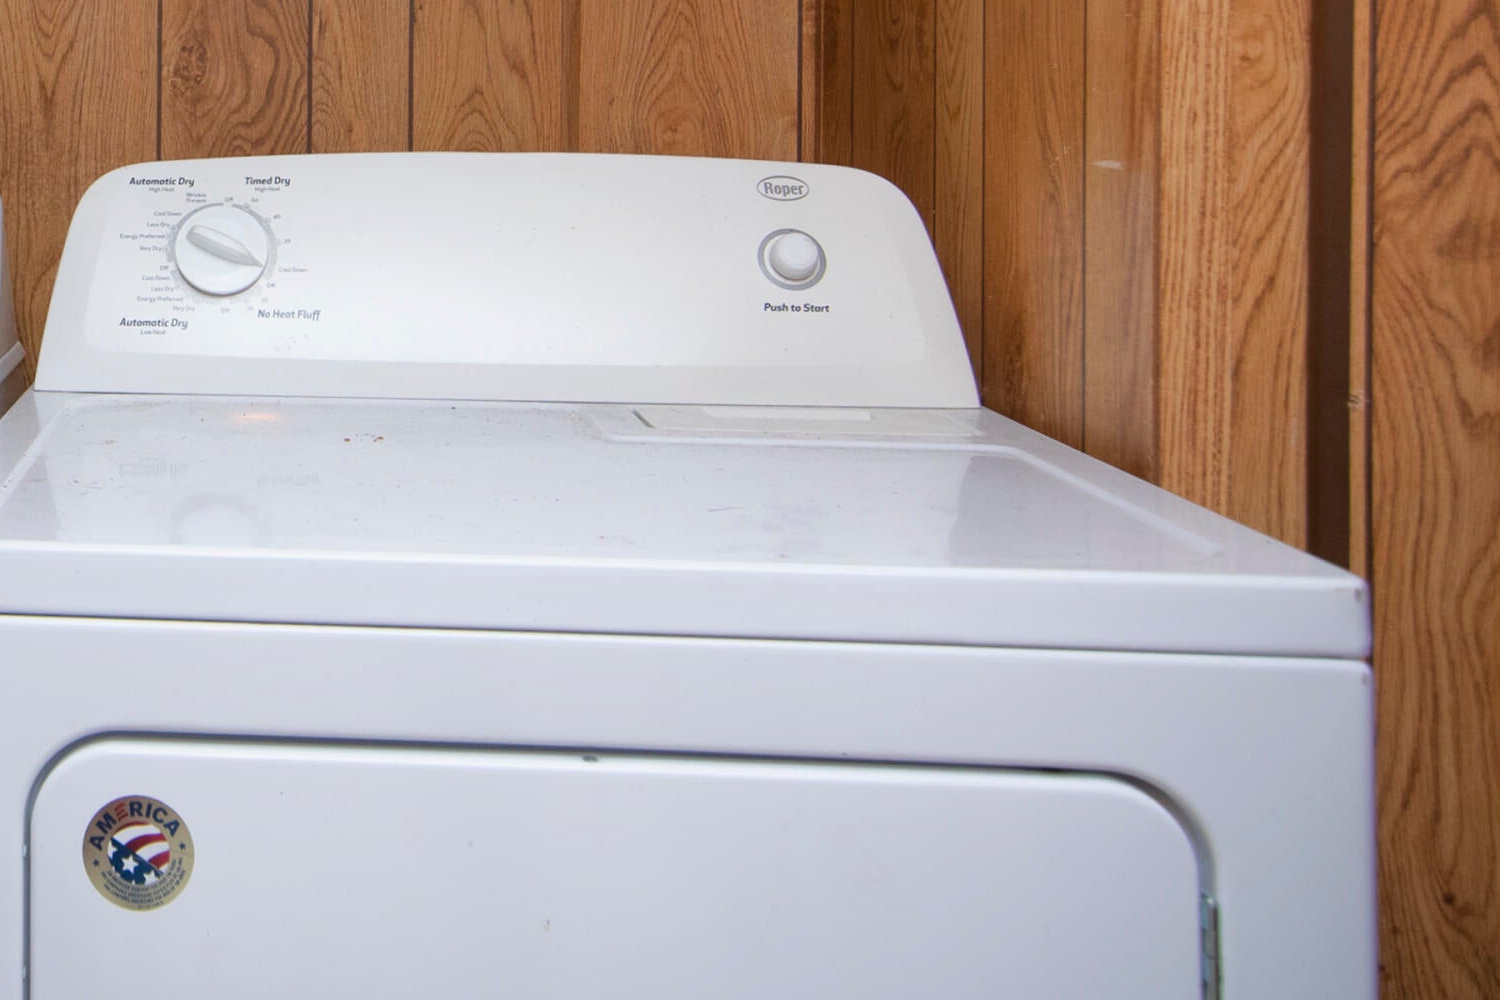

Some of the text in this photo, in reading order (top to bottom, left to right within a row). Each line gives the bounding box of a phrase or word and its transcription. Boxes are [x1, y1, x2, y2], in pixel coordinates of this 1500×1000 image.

[129, 177, 195, 188] Automatic Dry
[245, 176, 291, 187] Timed Dry
[763, 182, 804, 197] Roper
[764, 303, 830, 312] Push to Start
[257, 310, 321, 321] No Heat Fluff
[119, 317, 189, 330] Automatic Dry
[89, 801, 180, 851] AMERICA
